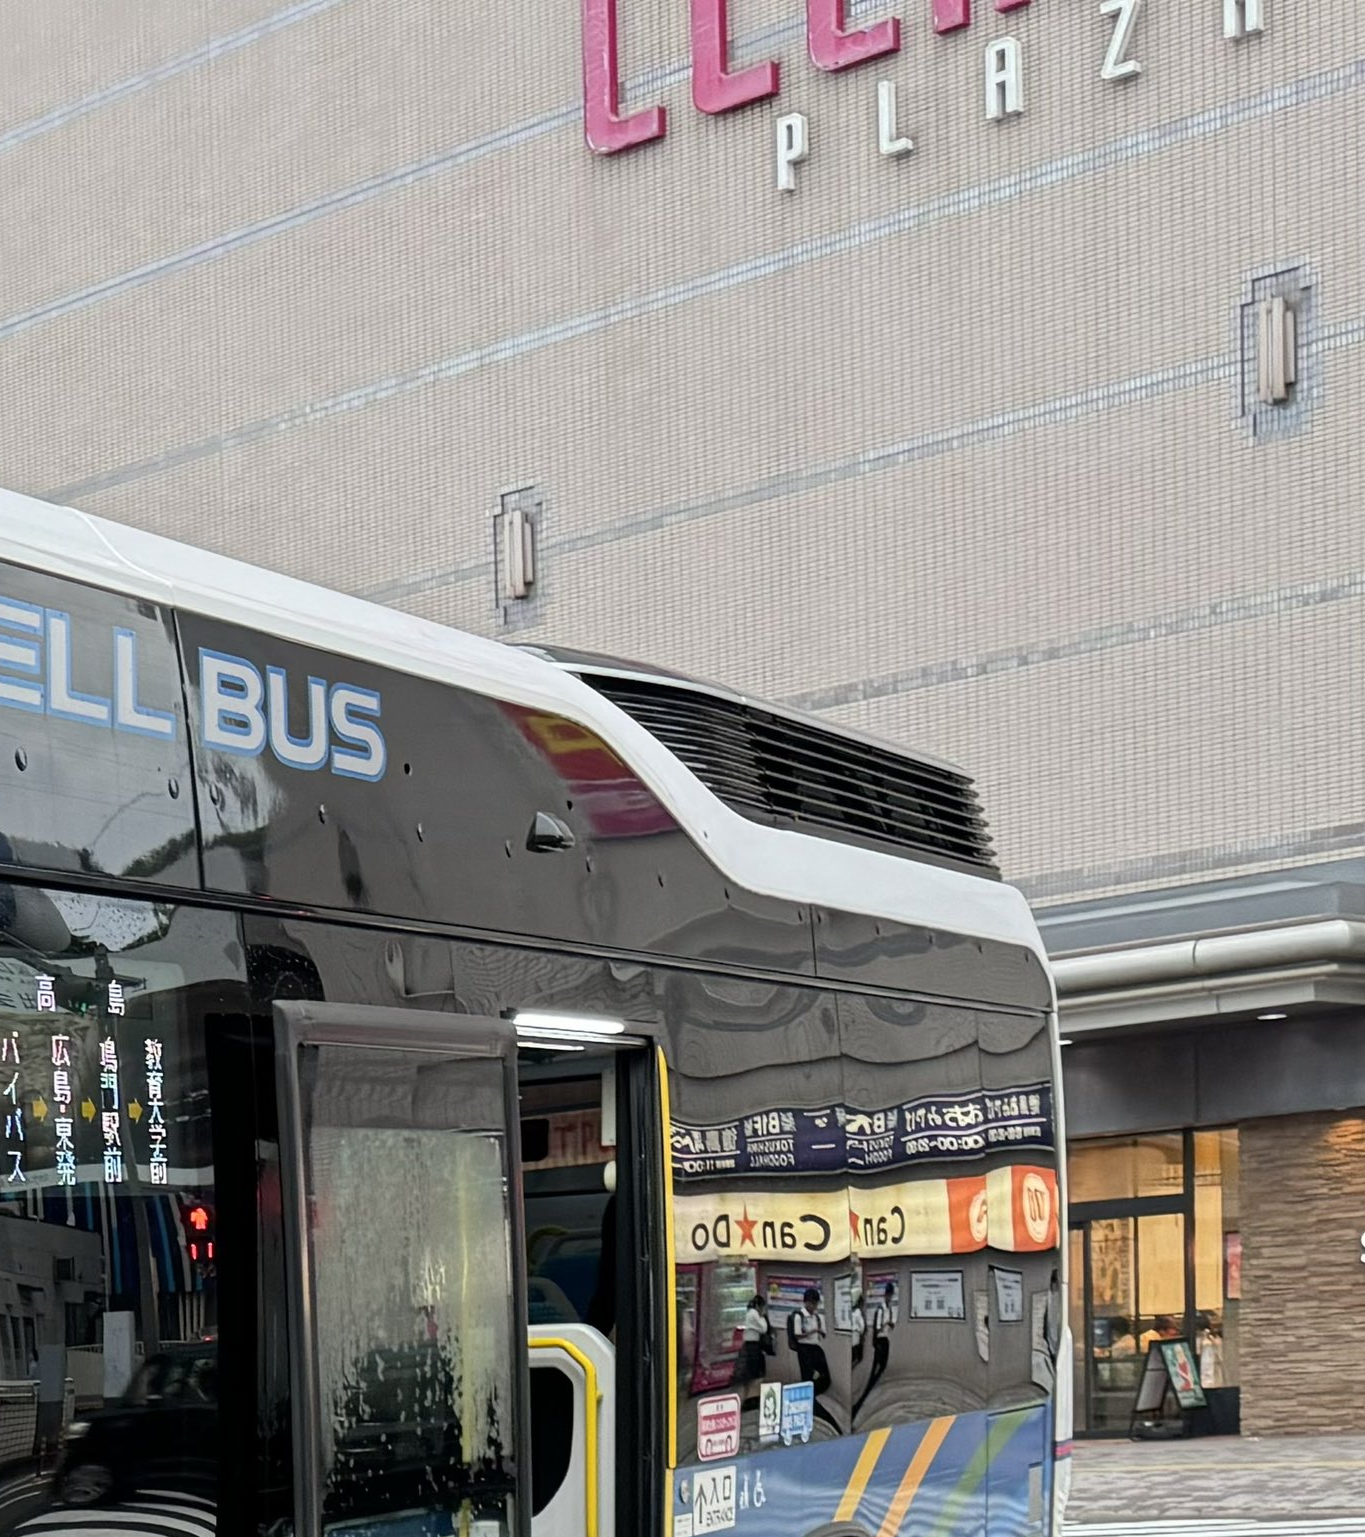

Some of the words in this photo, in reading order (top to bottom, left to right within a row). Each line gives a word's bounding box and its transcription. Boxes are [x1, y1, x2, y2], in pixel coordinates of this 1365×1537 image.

[196, 646, 389, 783] BUS
[35, 973, 125, 1016] 高島
[1, 1031, 27, 1183] バイパス
